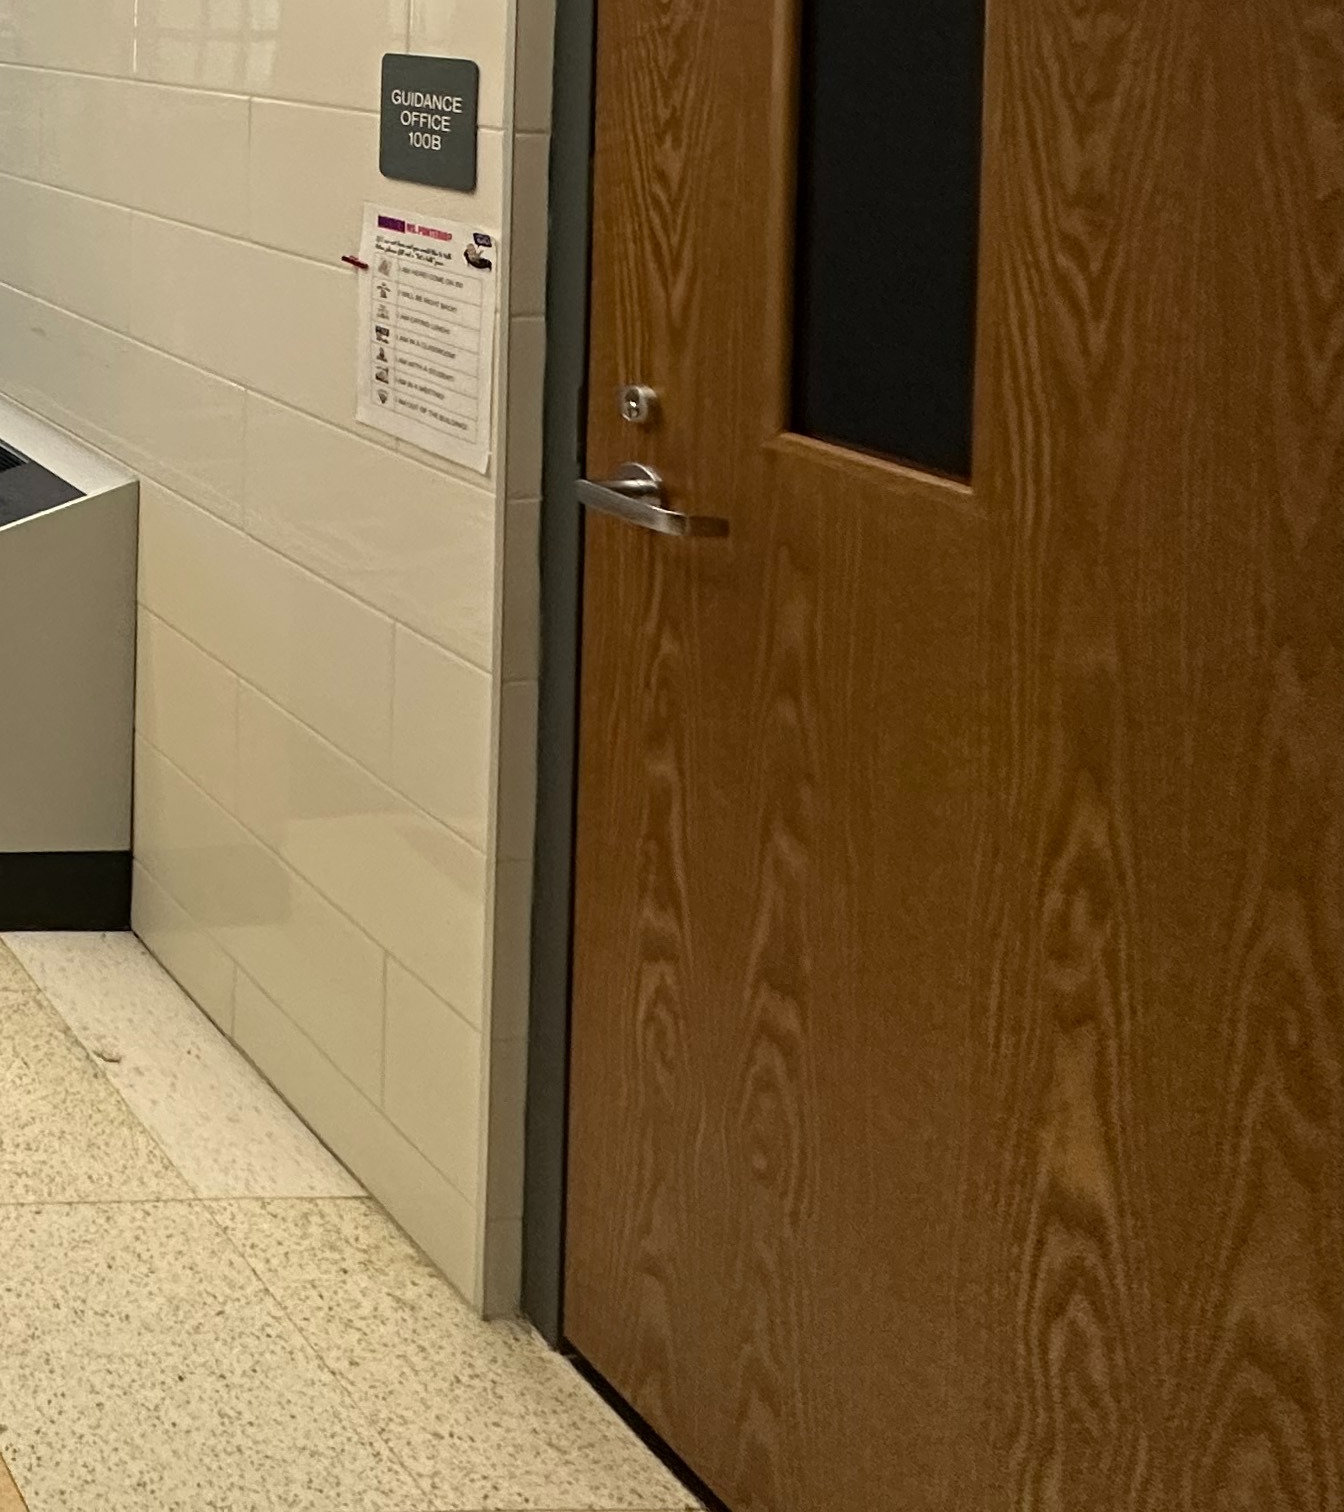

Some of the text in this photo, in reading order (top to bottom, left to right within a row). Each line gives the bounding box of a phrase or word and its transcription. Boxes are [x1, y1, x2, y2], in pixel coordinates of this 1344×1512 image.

[392, 89, 463, 113] GUIDANCE
[400, 110, 451, 132] OFFICE
[408, 131, 442, 150] 100B
